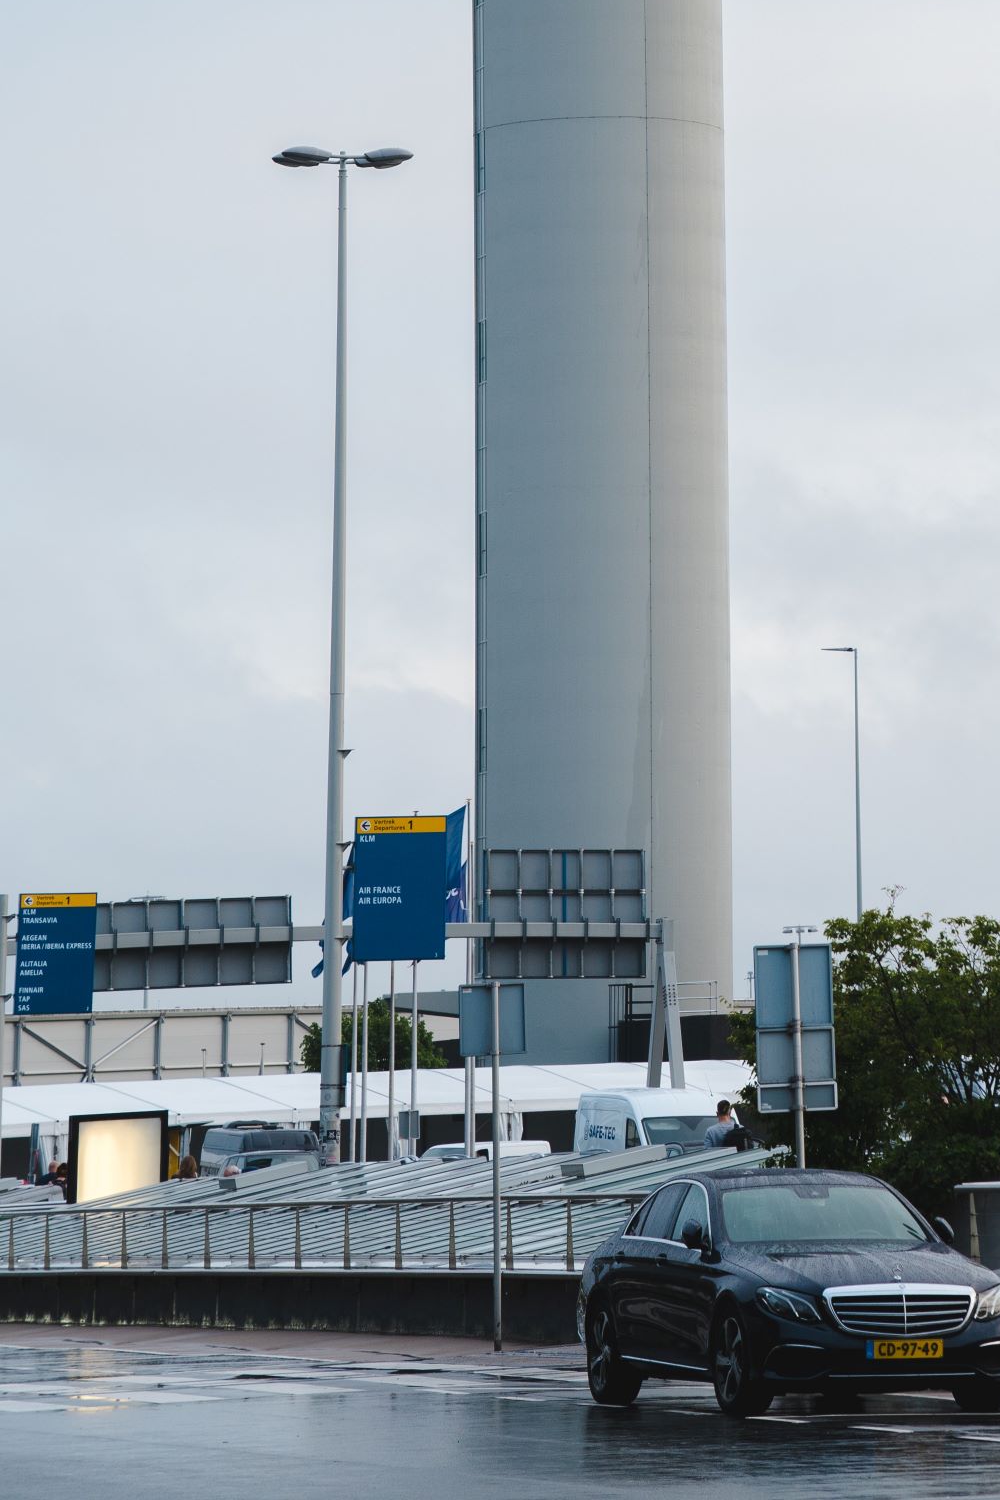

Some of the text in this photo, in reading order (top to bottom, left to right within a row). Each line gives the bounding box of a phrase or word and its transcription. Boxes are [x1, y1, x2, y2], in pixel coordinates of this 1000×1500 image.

[408, 820, 413, 830] 1
[359, 886, 401, 894] AIR FRANCE
[589, 1124, 616, 1140] SAFE-TEC
[878, 1343, 938, 1356] CD-97-49
